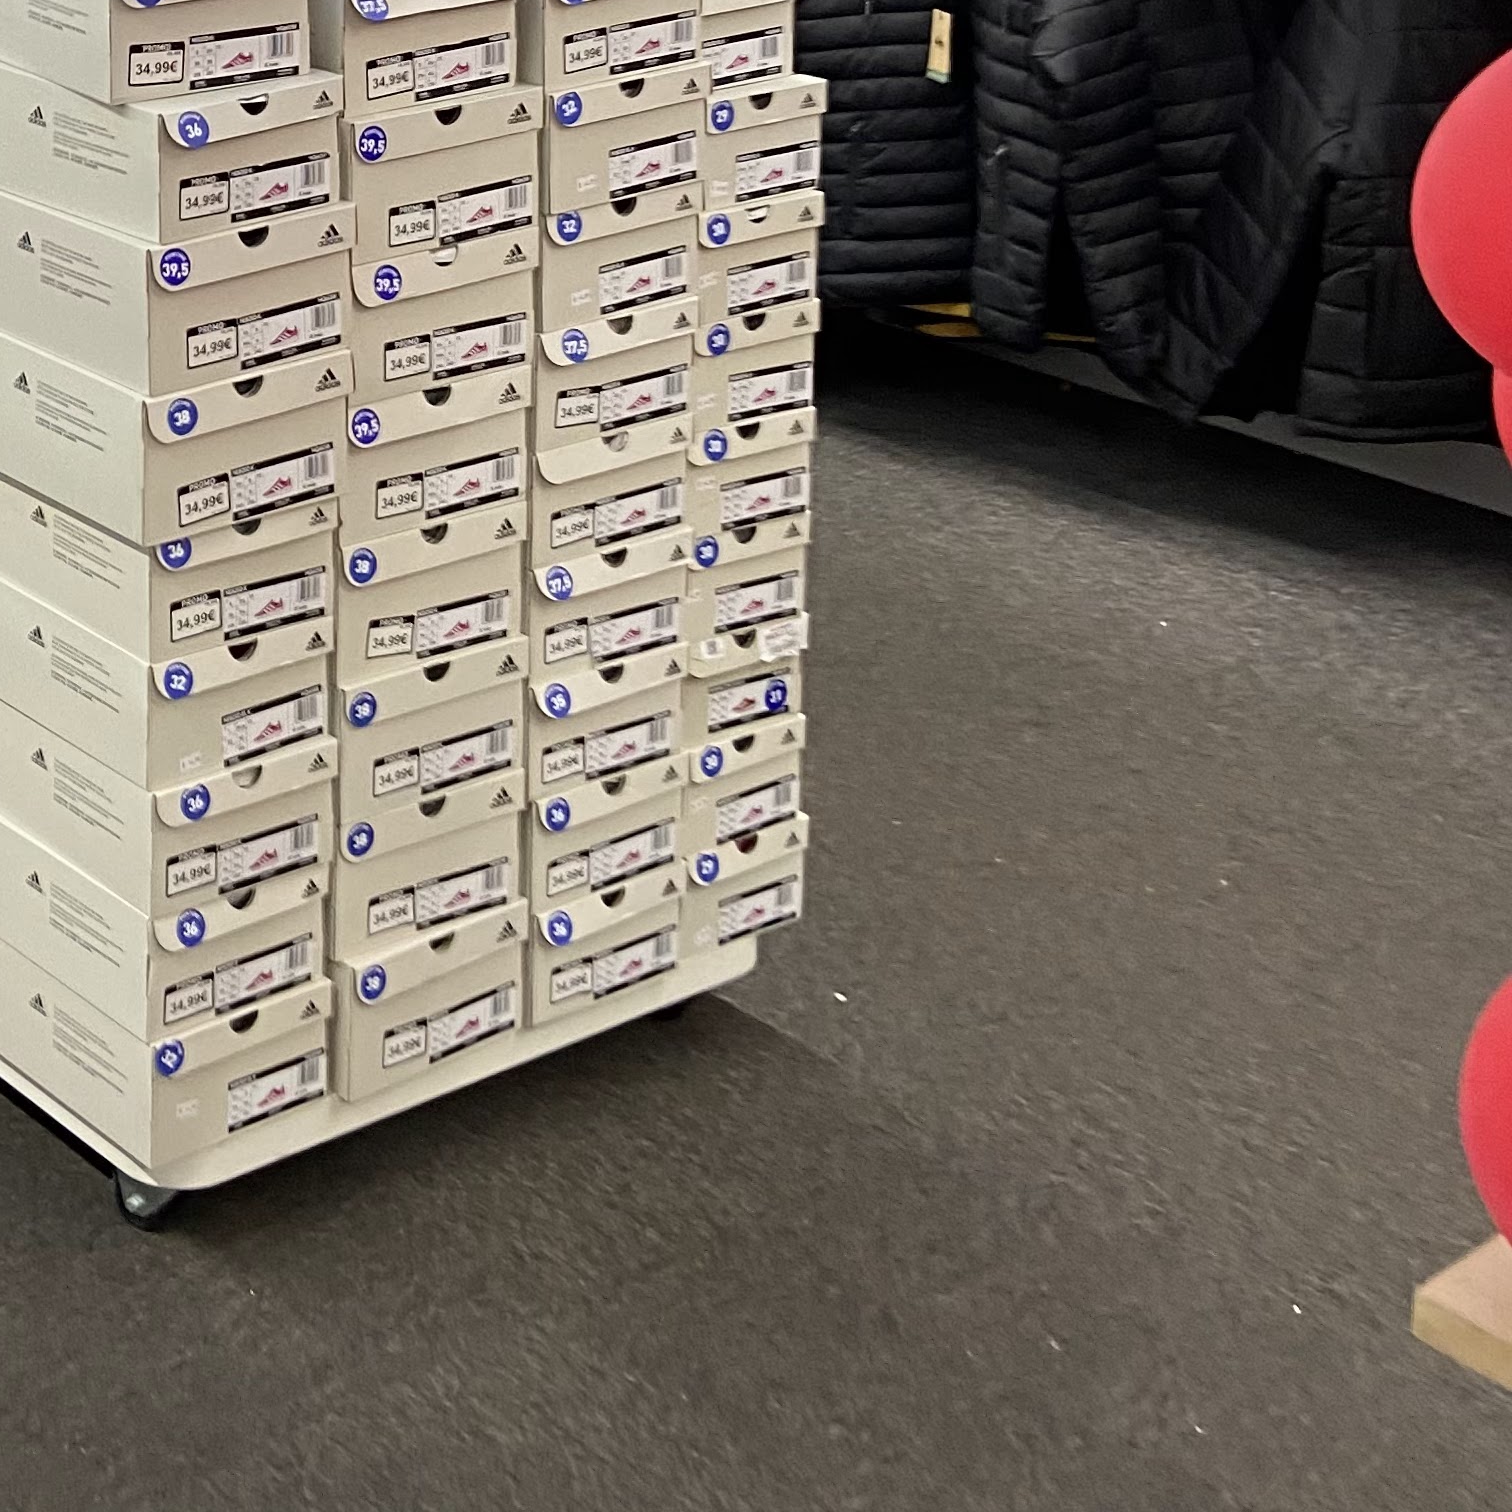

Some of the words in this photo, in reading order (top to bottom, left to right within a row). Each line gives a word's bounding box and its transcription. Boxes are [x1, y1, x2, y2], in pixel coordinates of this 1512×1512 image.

[568, 46, 604, 64] 34,99€
[135, 61, 178, 76] 34,99€
[372, 70, 410, 89] 34,99€
[185, 123, 203, 138] 36
[360, 137, 386, 155] 39,5
[190, 175, 218, 186] PROMO
[185, 192, 224, 209] 34,99€
[394, 219, 430, 238] 34,99€
[162, 262, 189, 279] 39,5
[375, 278, 400, 294] 39,5
[197, 321, 226, 334] PROMO
[193, 337, 232, 358] 34,99€
[390, 353, 426, 371] 34,99€
[355, 419, 380, 438] 39,5
[184, 493, 224, 514] 34,99€
[381, 491, 418, 509] 34,99€
[168, 542, 185, 559] 36
[176, 609, 216, 630] 34,99€
[170, 675, 187, 691] 32
[187, 796, 204, 811] 36
[172, 864, 211, 885] 34,99€
[183, 921, 200, 936] 36
[169, 990, 208, 1013] 34,99€
